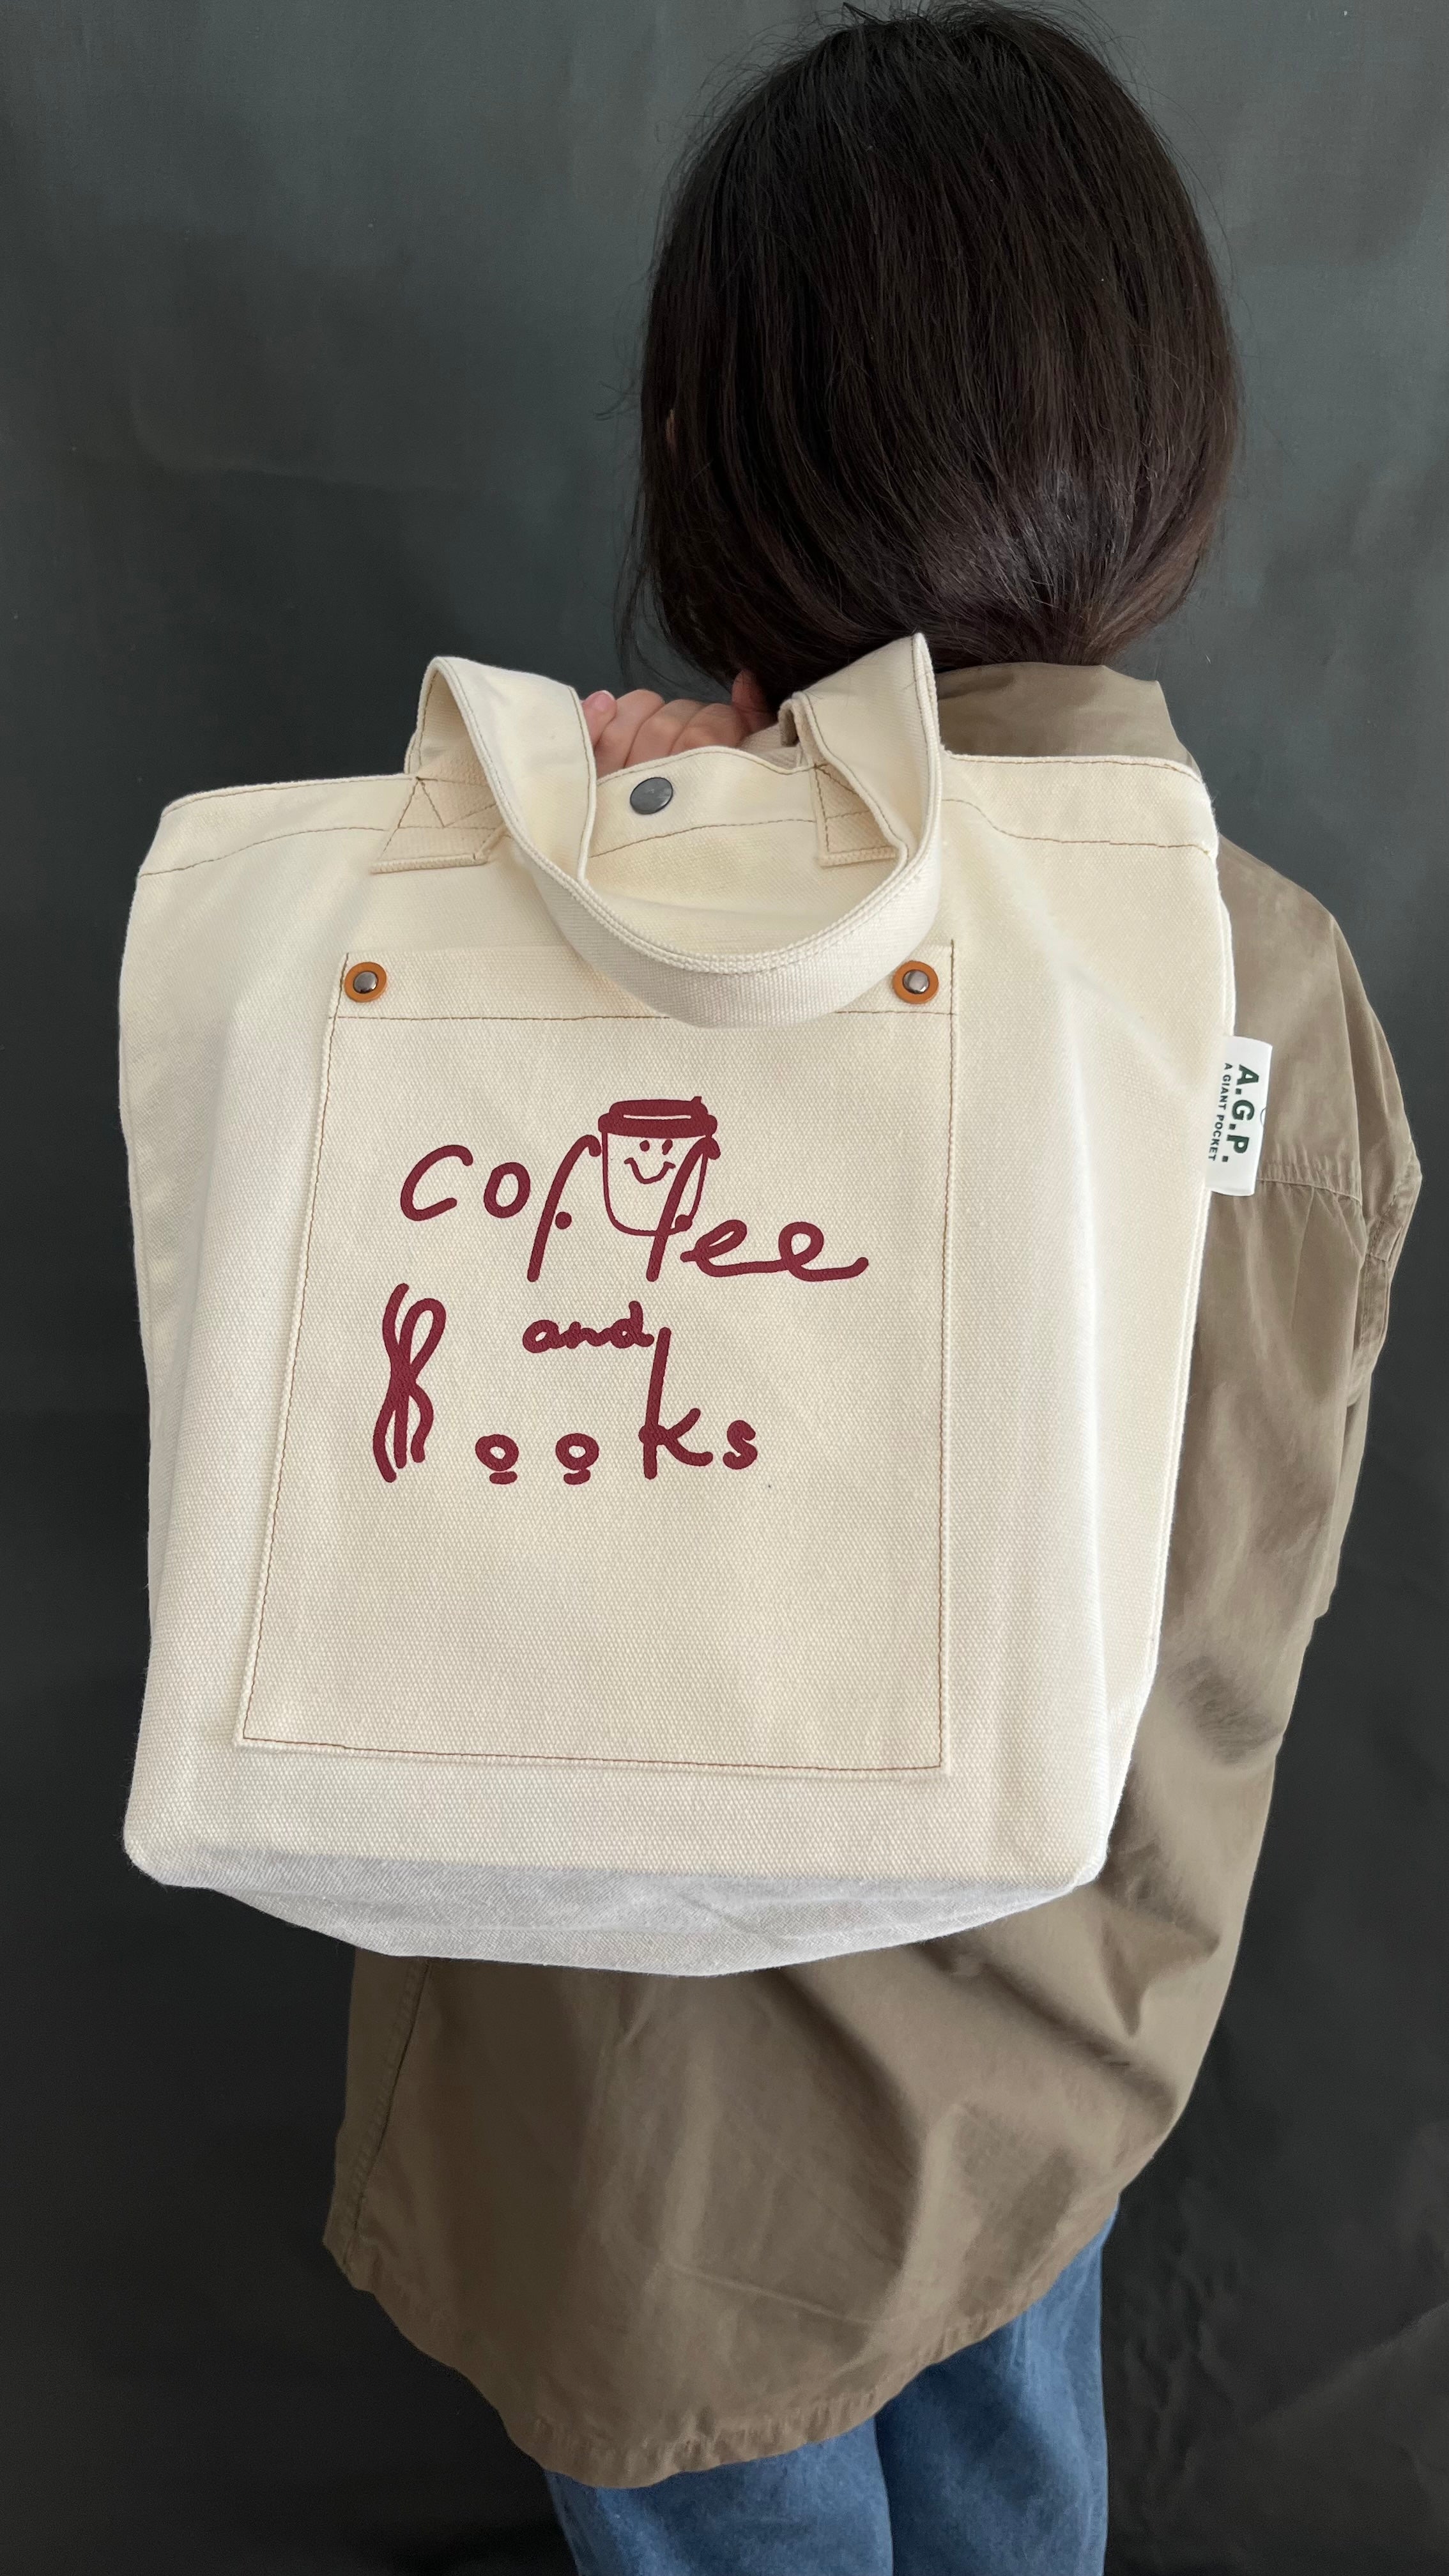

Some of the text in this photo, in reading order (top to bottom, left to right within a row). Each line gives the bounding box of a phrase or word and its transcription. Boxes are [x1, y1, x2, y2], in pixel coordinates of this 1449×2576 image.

[1208, 1062, 1233, 1162] A GIANT POCKET
[1221, 1064, 1260, 1163] A.G.P.
[523, 1300, 655, 1353] and
